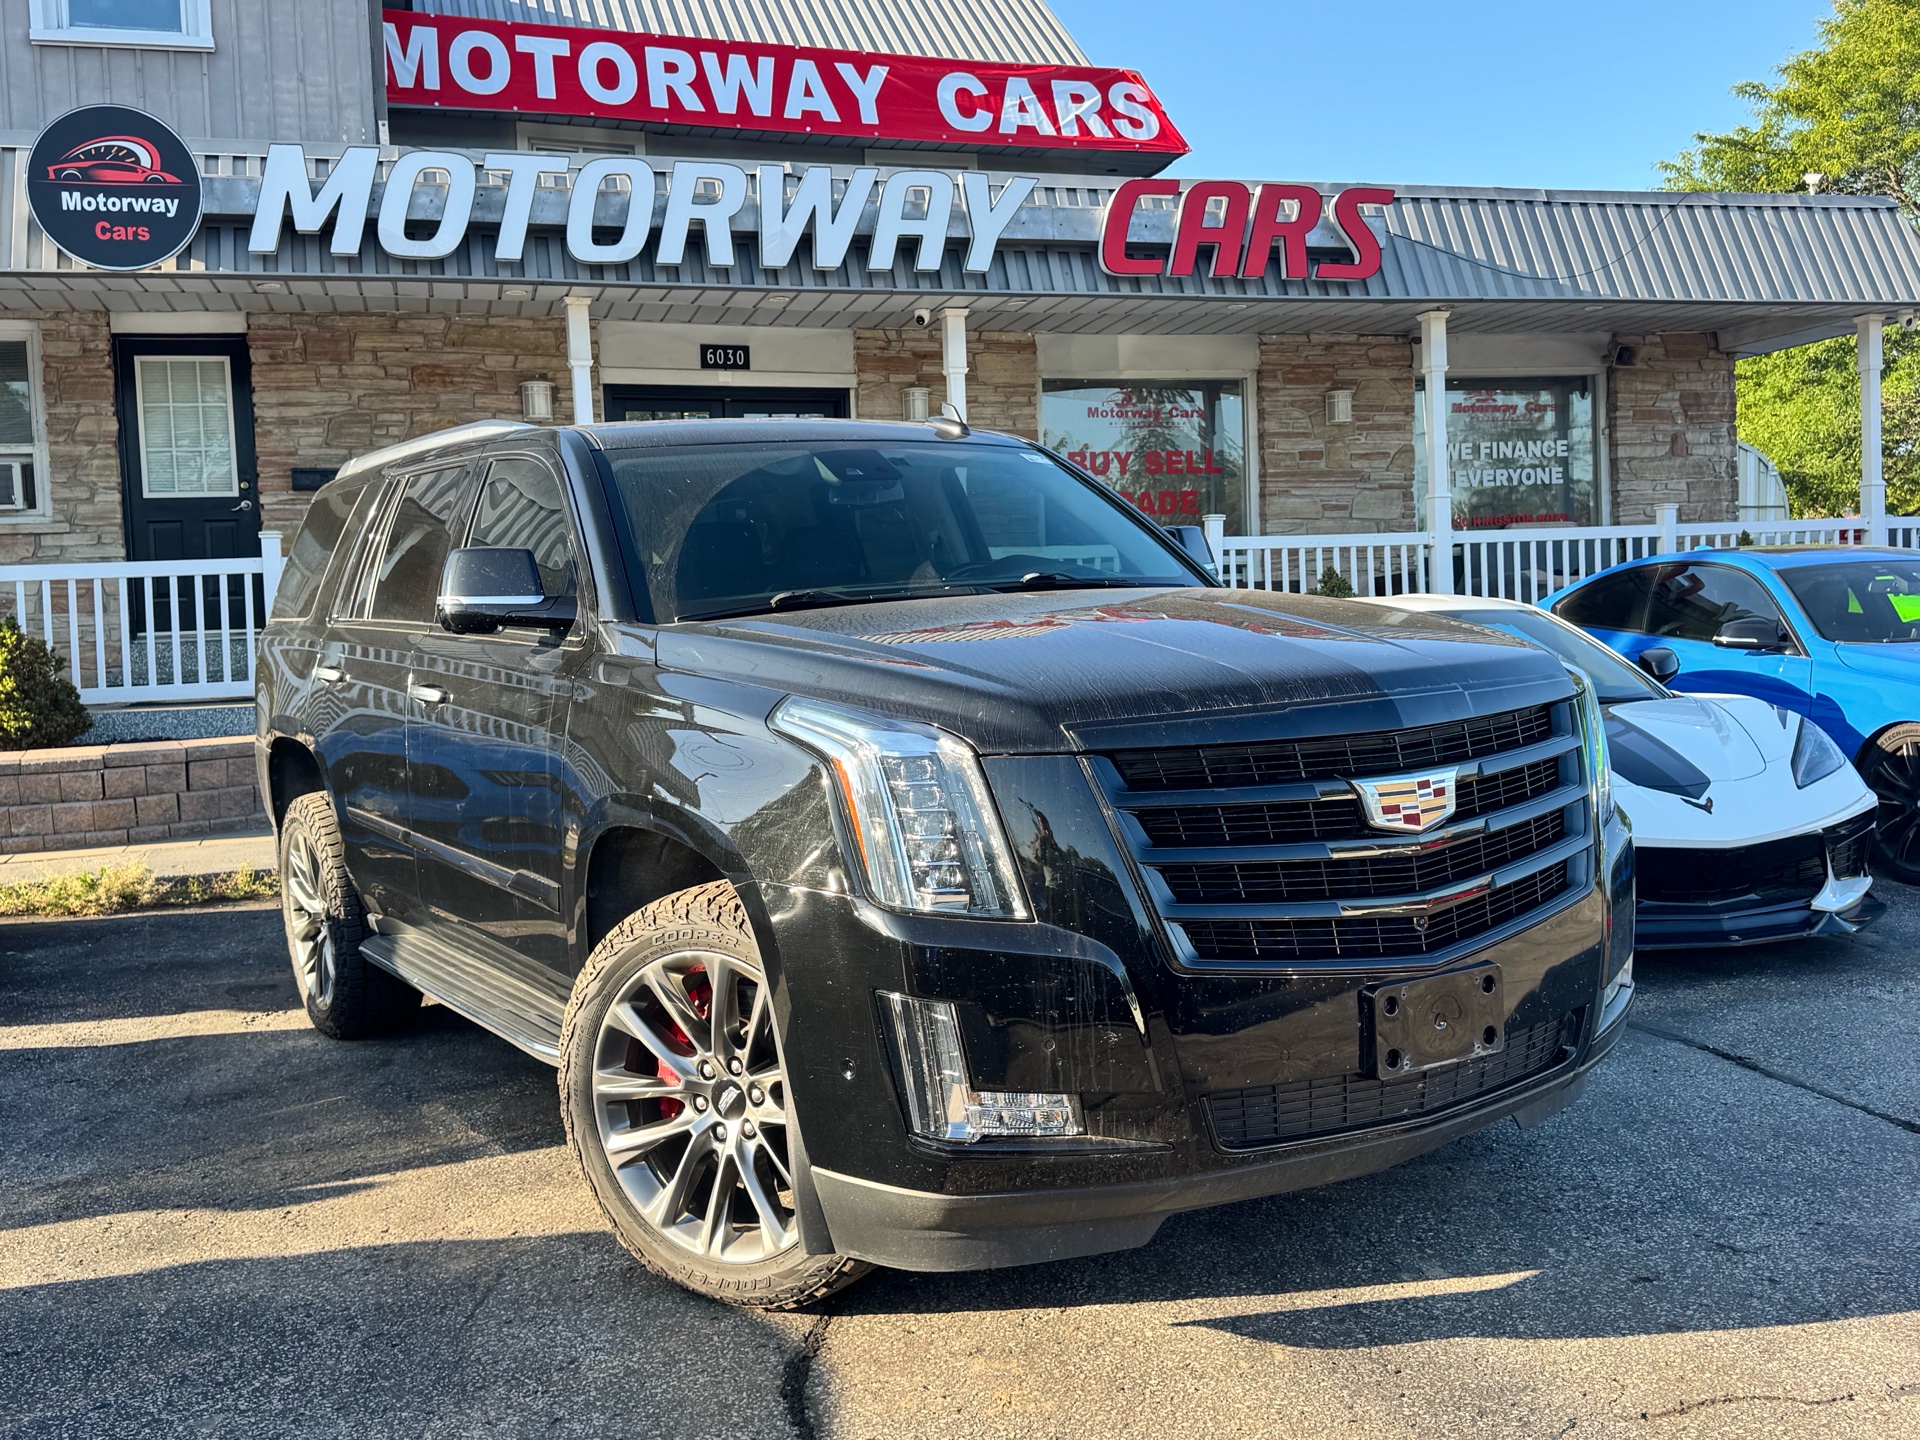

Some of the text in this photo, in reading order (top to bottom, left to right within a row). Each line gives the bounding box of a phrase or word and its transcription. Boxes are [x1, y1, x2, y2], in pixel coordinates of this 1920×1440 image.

[382, 22, 1160, 140] MOTORWAY CARS
[61, 191, 179, 218] Motorway
[248, 143, 1395, 281] MOTORWAY CARS
[95, 221, 151, 241] Cars
[706, 349, 745, 366] 6030
[1087, 406, 1205, 421] Motorway Cars
[1451, 401, 1557, 415] Motorway Cars
[1480, 440, 1569, 460] FINANCE
[1068, 450, 1223, 476] BUY SELL
[1455, 467, 1564, 488] EVERYONE
[652, 929, 739, 948] COOPER
